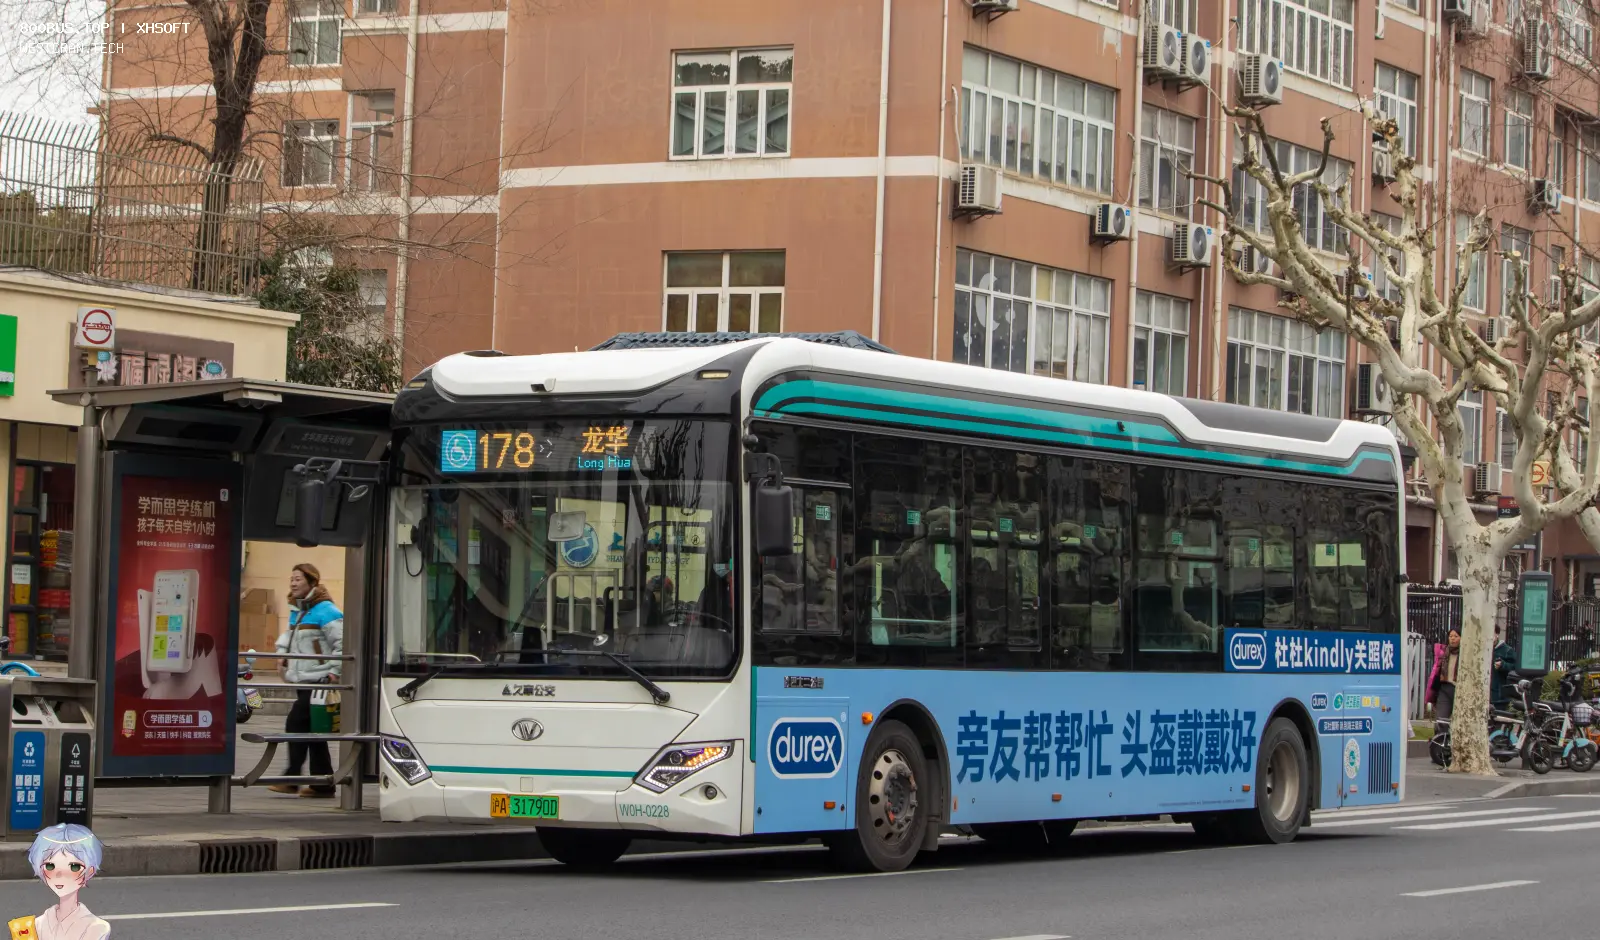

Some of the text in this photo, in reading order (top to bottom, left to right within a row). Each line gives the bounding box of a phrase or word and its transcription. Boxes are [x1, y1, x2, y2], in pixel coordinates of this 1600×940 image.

[479, 433, 535, 468] 178
[582, 426, 628, 454] 龙华
[577, 456, 632, 470] Long Hua
[138, 496, 216, 519] 学而思学练机
[137, 517, 216, 537] 孩子每天自学1小时
[1233, 638, 1264, 664] durex
[1274, 636, 1394, 673] 杜杜kindly关照侬
[1312, 695, 1327, 707] durex
[775, 726, 838, 769] durex
[956, 708, 1257, 784] 旁友帮帮忙 头盔戴戴好
[512, 797, 558, 816] 31790D
